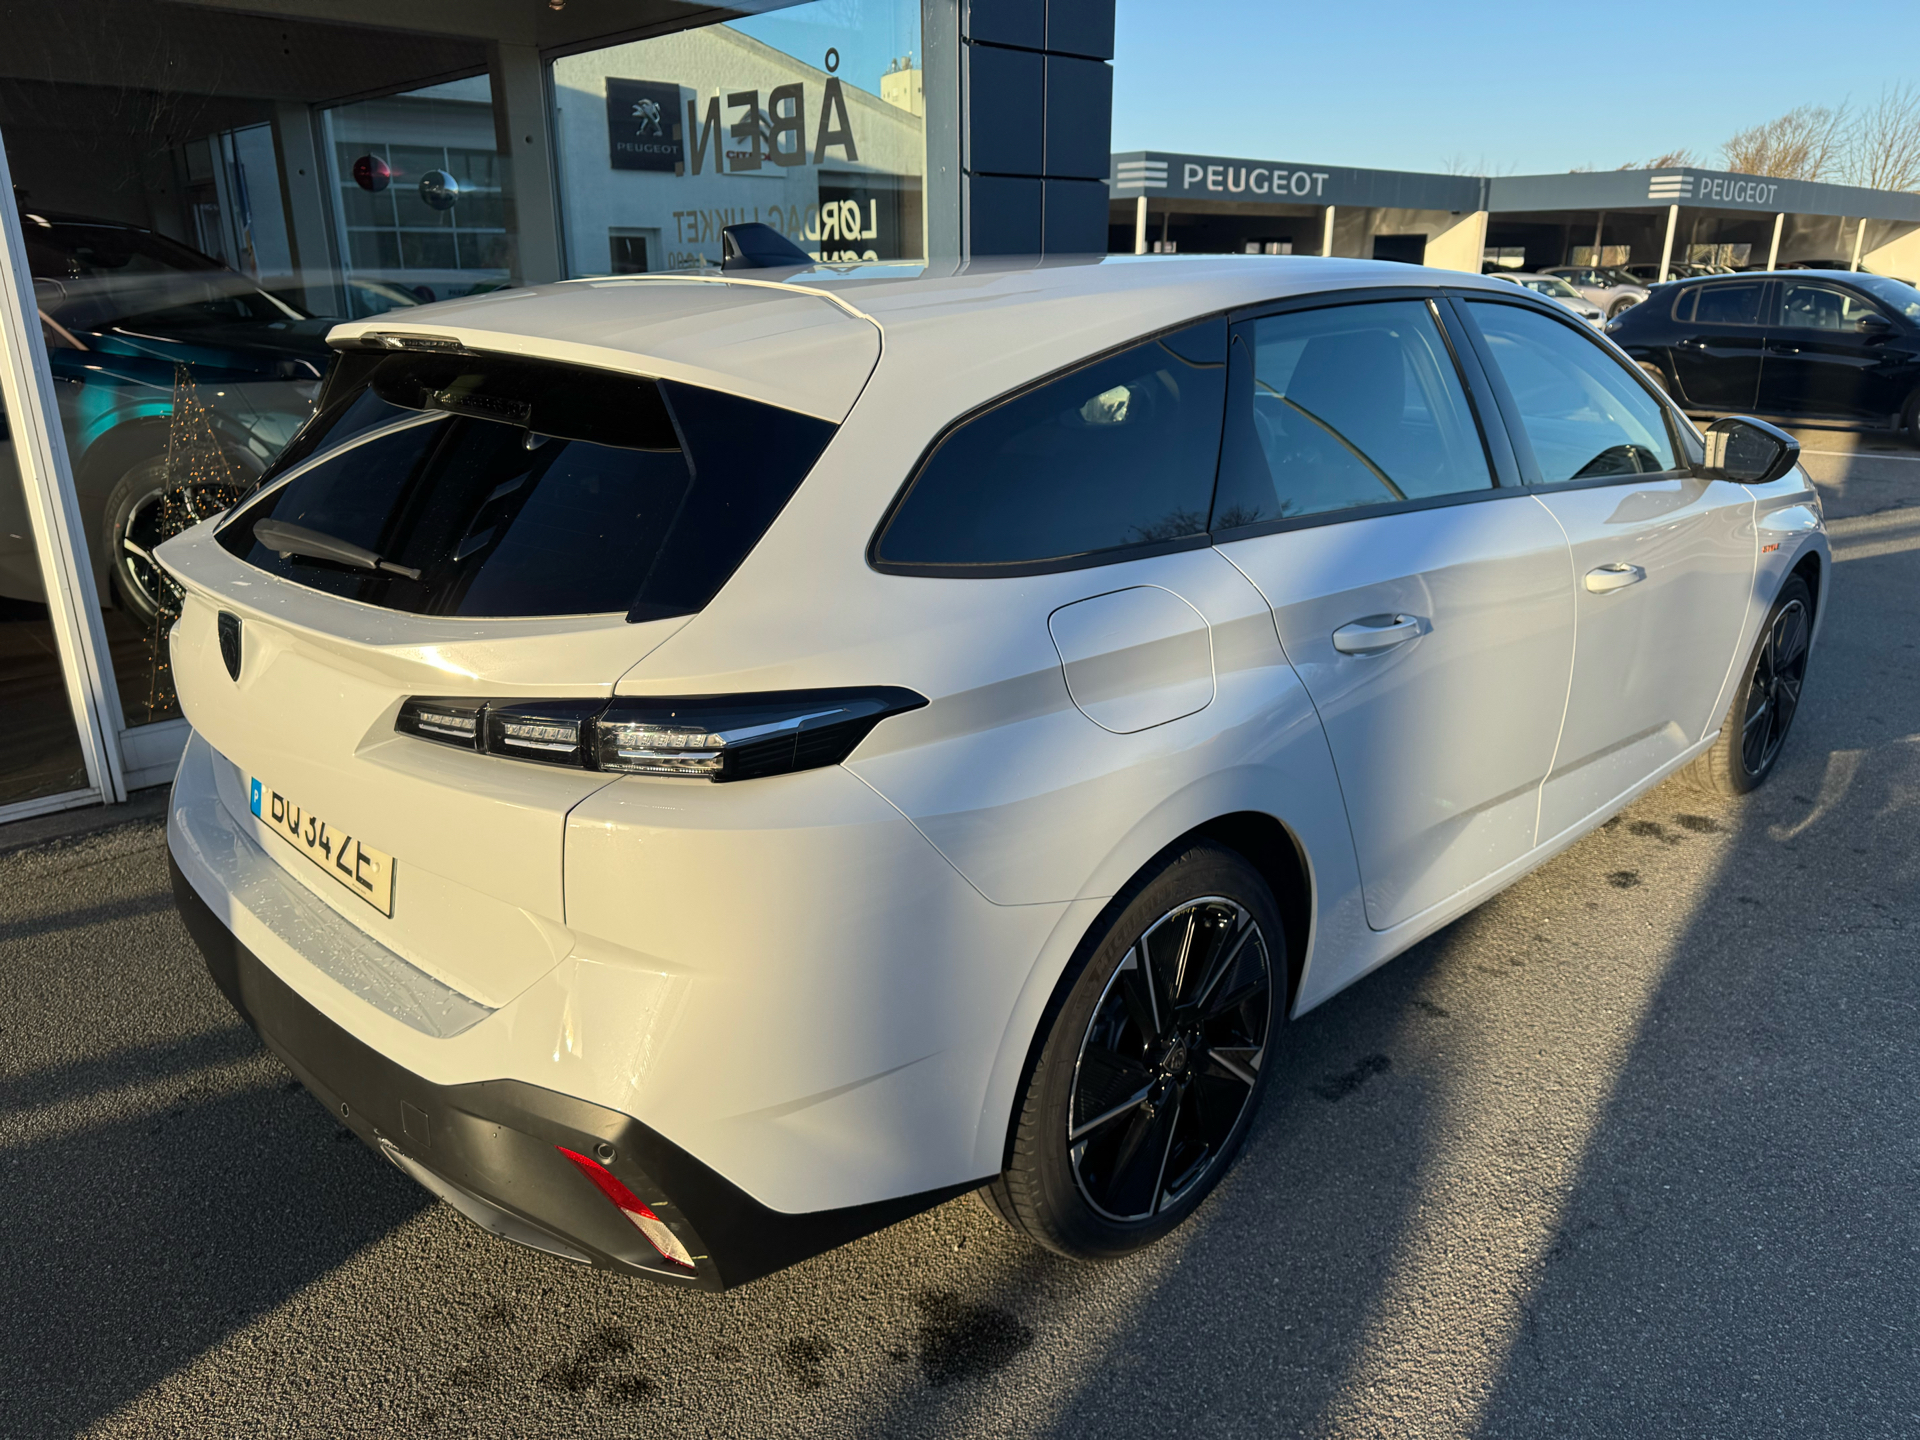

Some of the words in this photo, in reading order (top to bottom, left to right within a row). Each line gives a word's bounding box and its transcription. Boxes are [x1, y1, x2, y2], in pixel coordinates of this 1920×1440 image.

[616, 141, 679, 155] PEUGEOT
[1183, 163, 1330, 197] PEUGEOT
[1699, 177, 1778, 205] PEUGEOT
